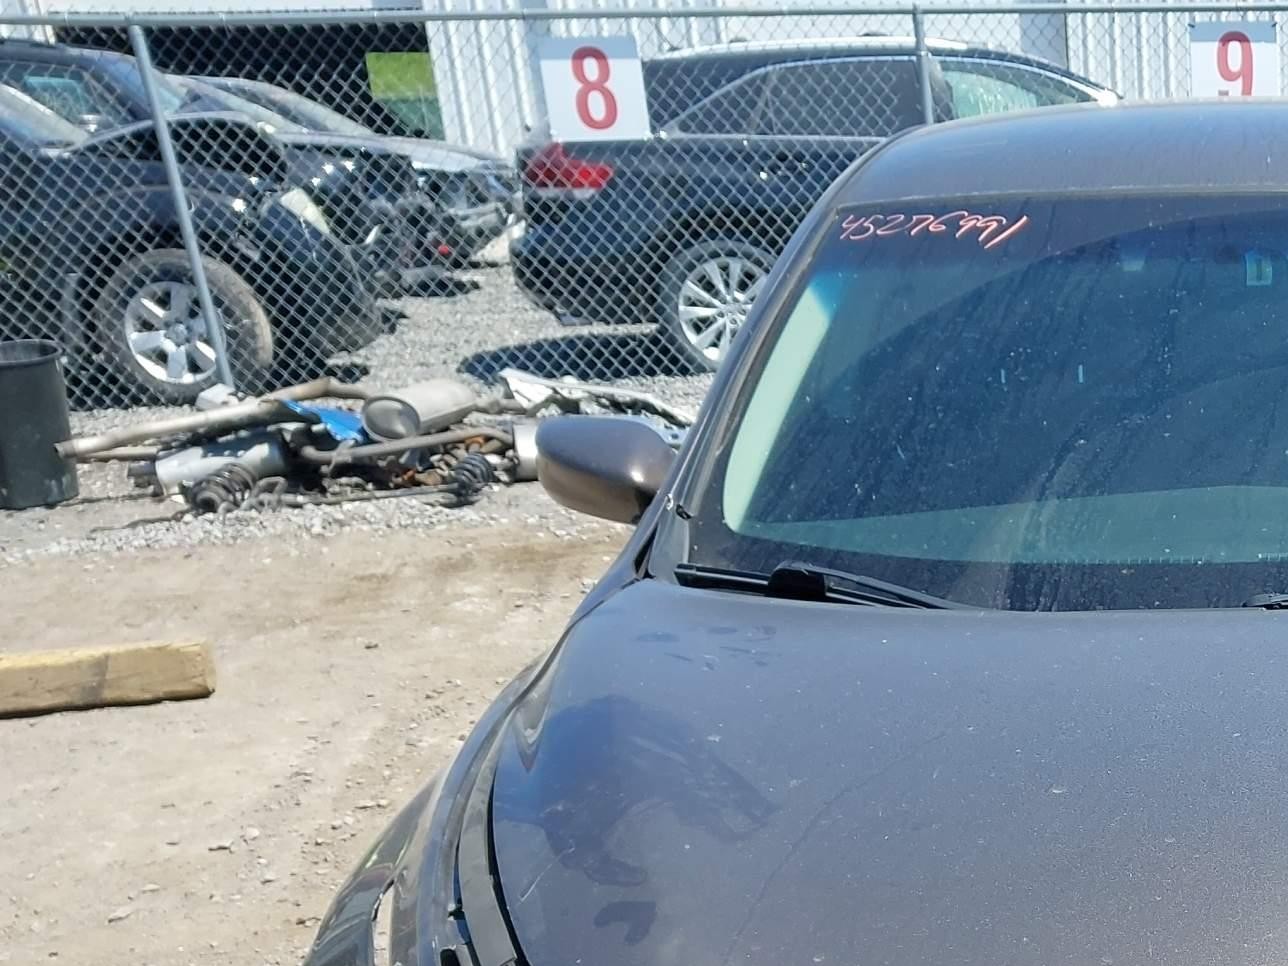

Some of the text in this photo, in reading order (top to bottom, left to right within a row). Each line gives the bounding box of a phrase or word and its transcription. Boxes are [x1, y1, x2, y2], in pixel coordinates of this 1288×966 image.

[571, 45, 618, 130] 8
[1217, 30, 1253, 96] 9
[839, 210, 1029, 250] 45276991
